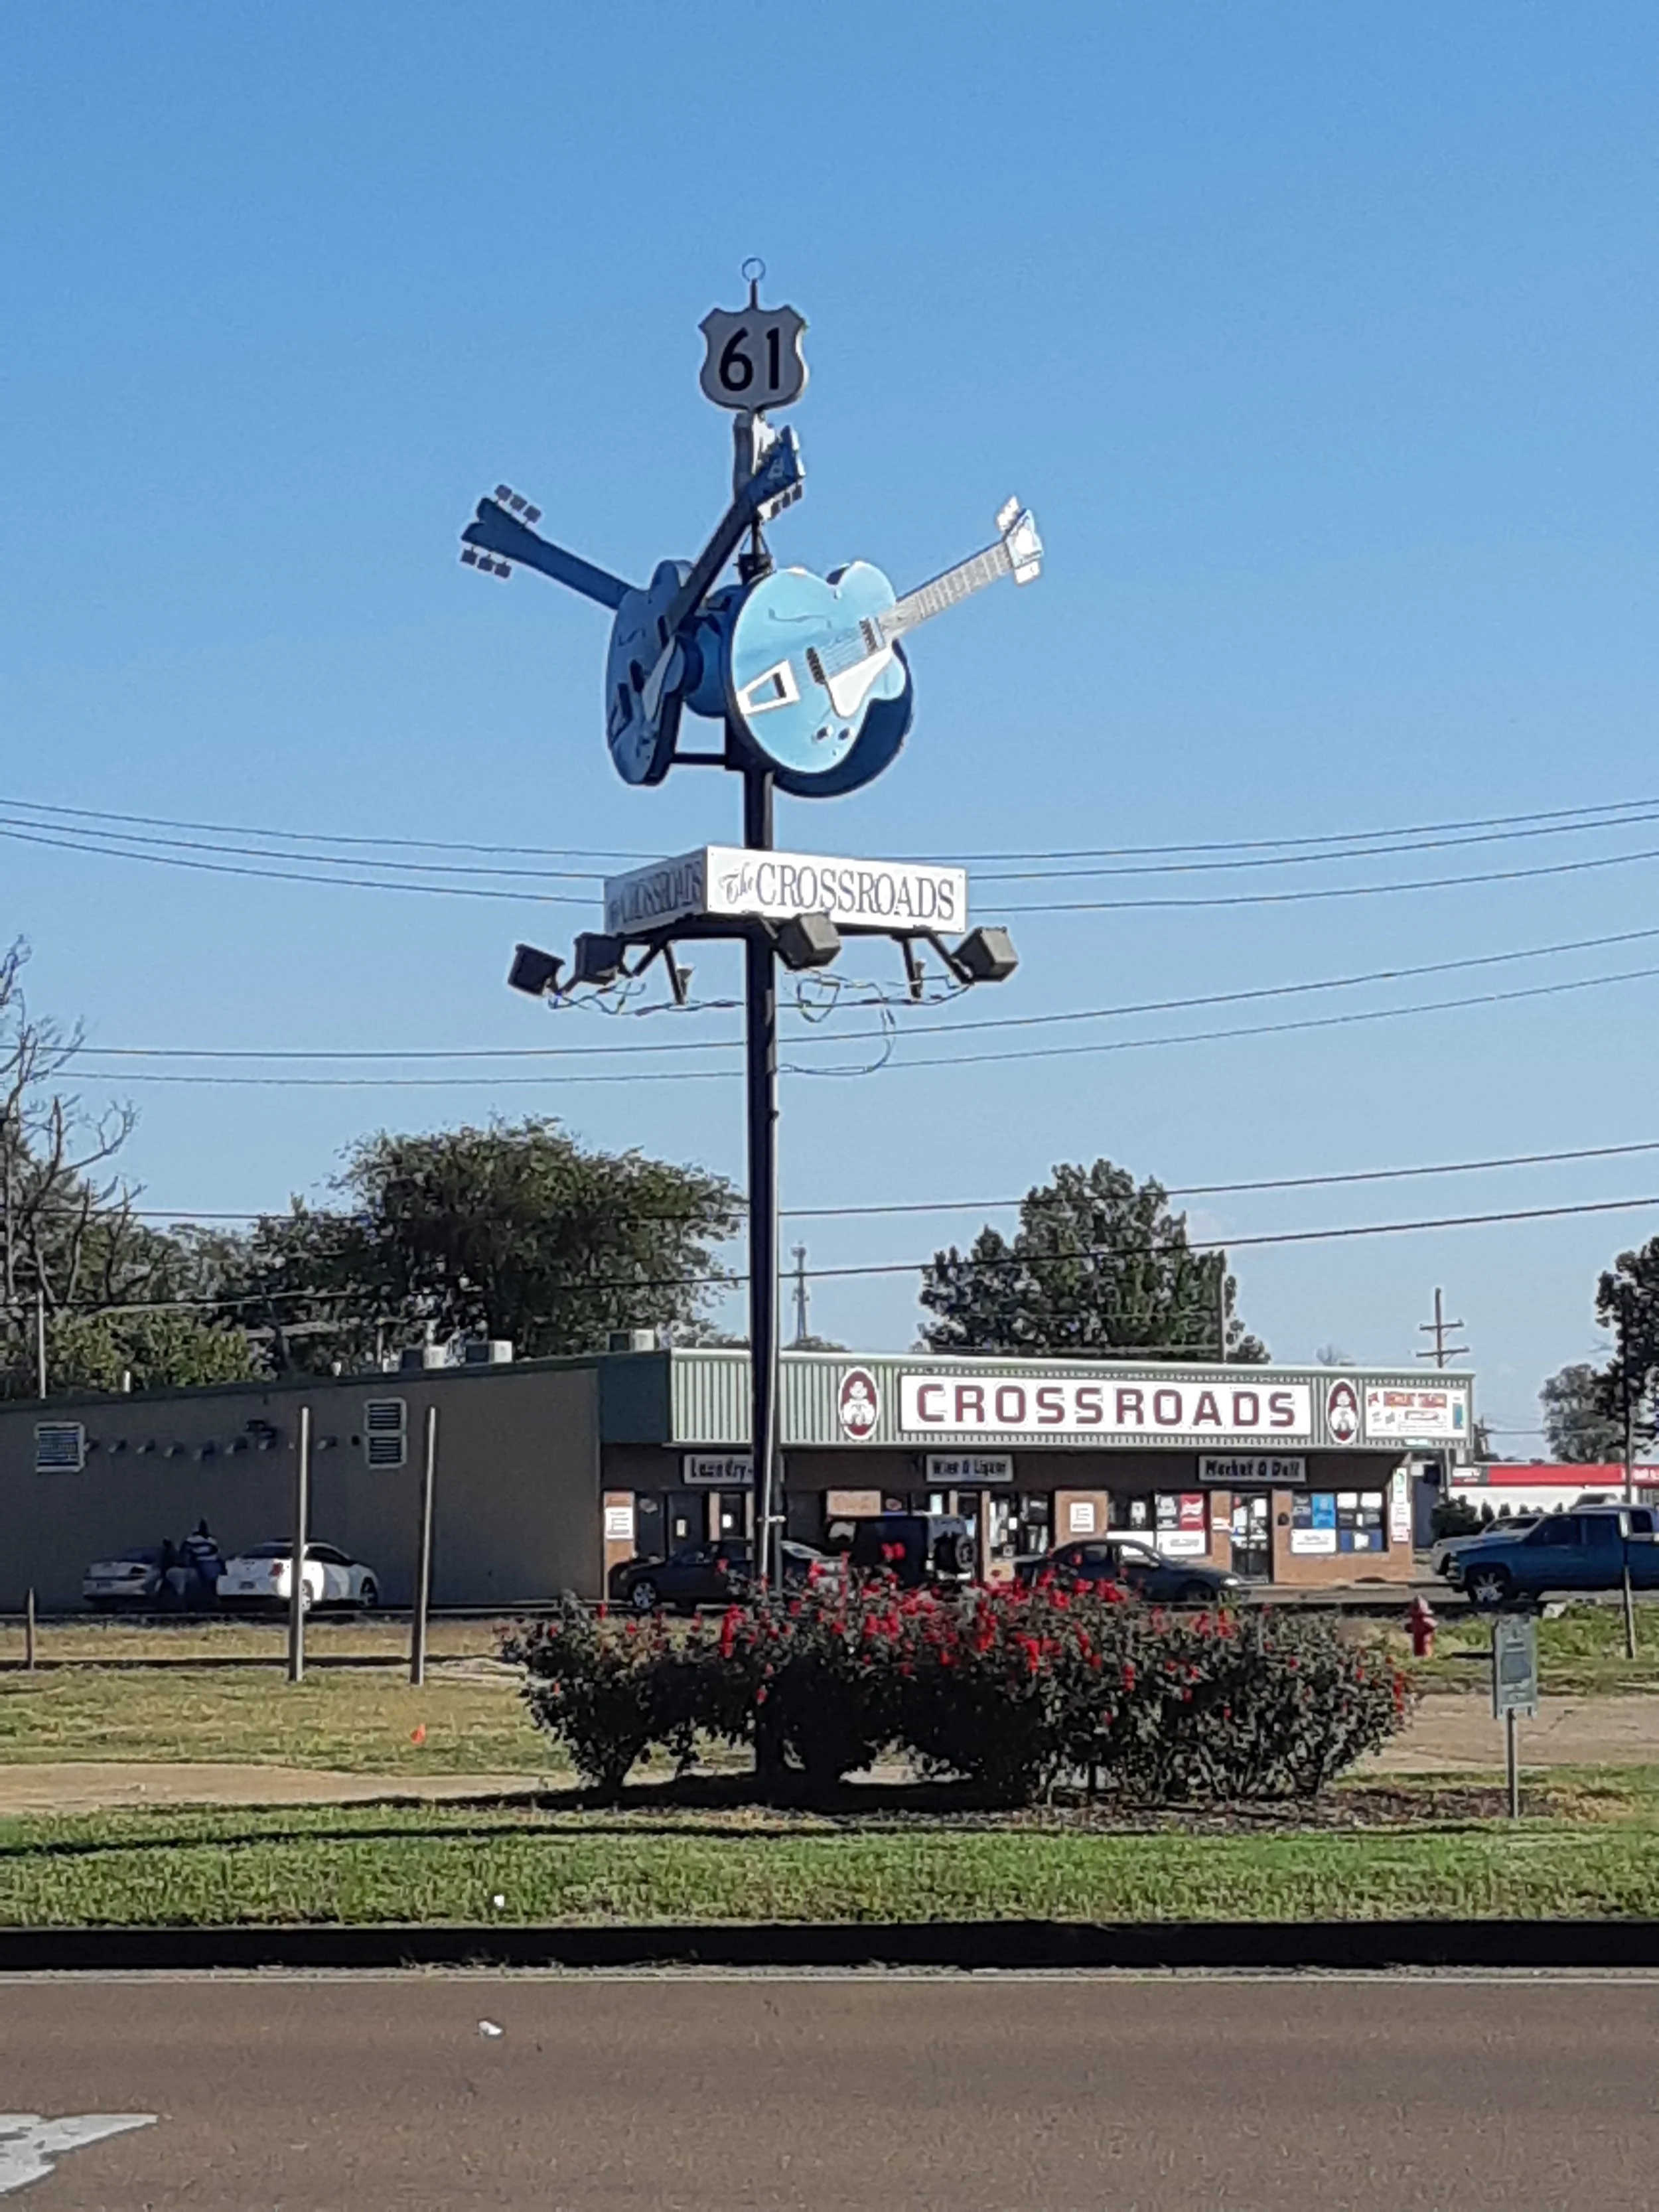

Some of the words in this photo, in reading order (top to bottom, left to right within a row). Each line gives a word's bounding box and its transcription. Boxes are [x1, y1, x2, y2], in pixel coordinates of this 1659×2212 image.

[719, 326, 780, 392] 61
[719, 862, 754, 904] The
[755, 862, 955, 921] CROSSROADS
[916, 1382, 1296, 1428] CROSSROADS
